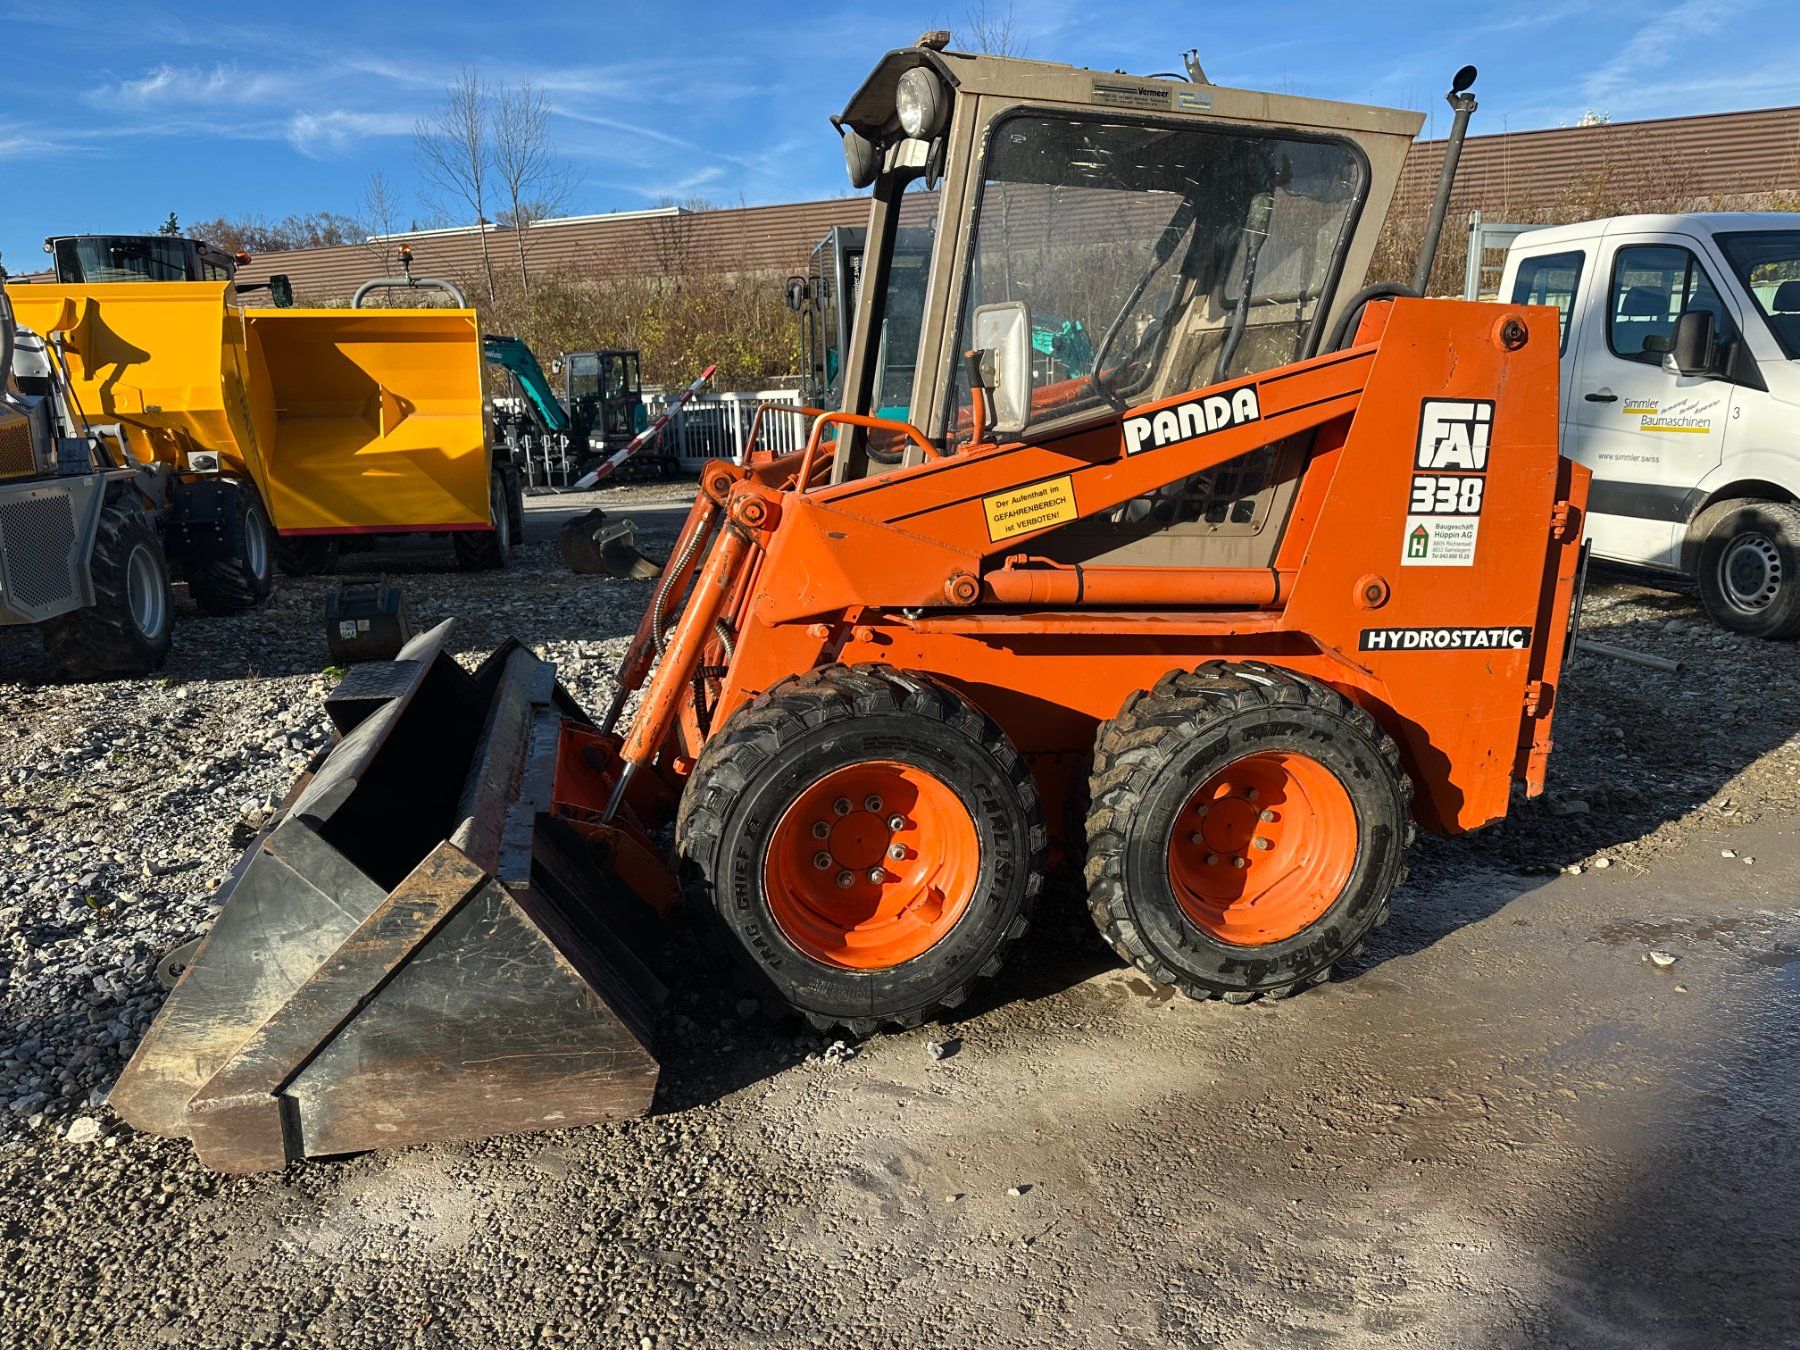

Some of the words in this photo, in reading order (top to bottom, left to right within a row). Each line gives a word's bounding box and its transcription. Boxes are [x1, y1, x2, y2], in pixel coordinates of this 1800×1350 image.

[1137, 87, 1169, 98] Vermeer
[1624, 398, 1659, 409] Simmler
[1732, 407, 1740, 419] 3
[1123, 388, 1260, 454] PANDA
[1641, 415, 1711, 428] Baumaschinen
[995, 500, 1009, 508] Der
[1012, 489, 1048, 504] Aufenthalt
[1411, 477, 1483, 513] 338
[993, 496, 1066, 522] GEFAHRENBEREICH
[1005, 524, 1015, 532] ist
[1017, 511, 1060, 528] VERBOTEN!
[1435, 523, 1474, 531] Baugeschäft
[1435, 530, 1460, 540] Hüppin
[1461, 531, 1473, 539] AG
[1367, 629, 1525, 649] HYDROSTATIC
[744, 812, 761, 841] XT
[971, 783, 1012, 914] CARLISLE
[734, 846, 750, 911] CHIEF
[745, 923, 787, 973] TRAC
